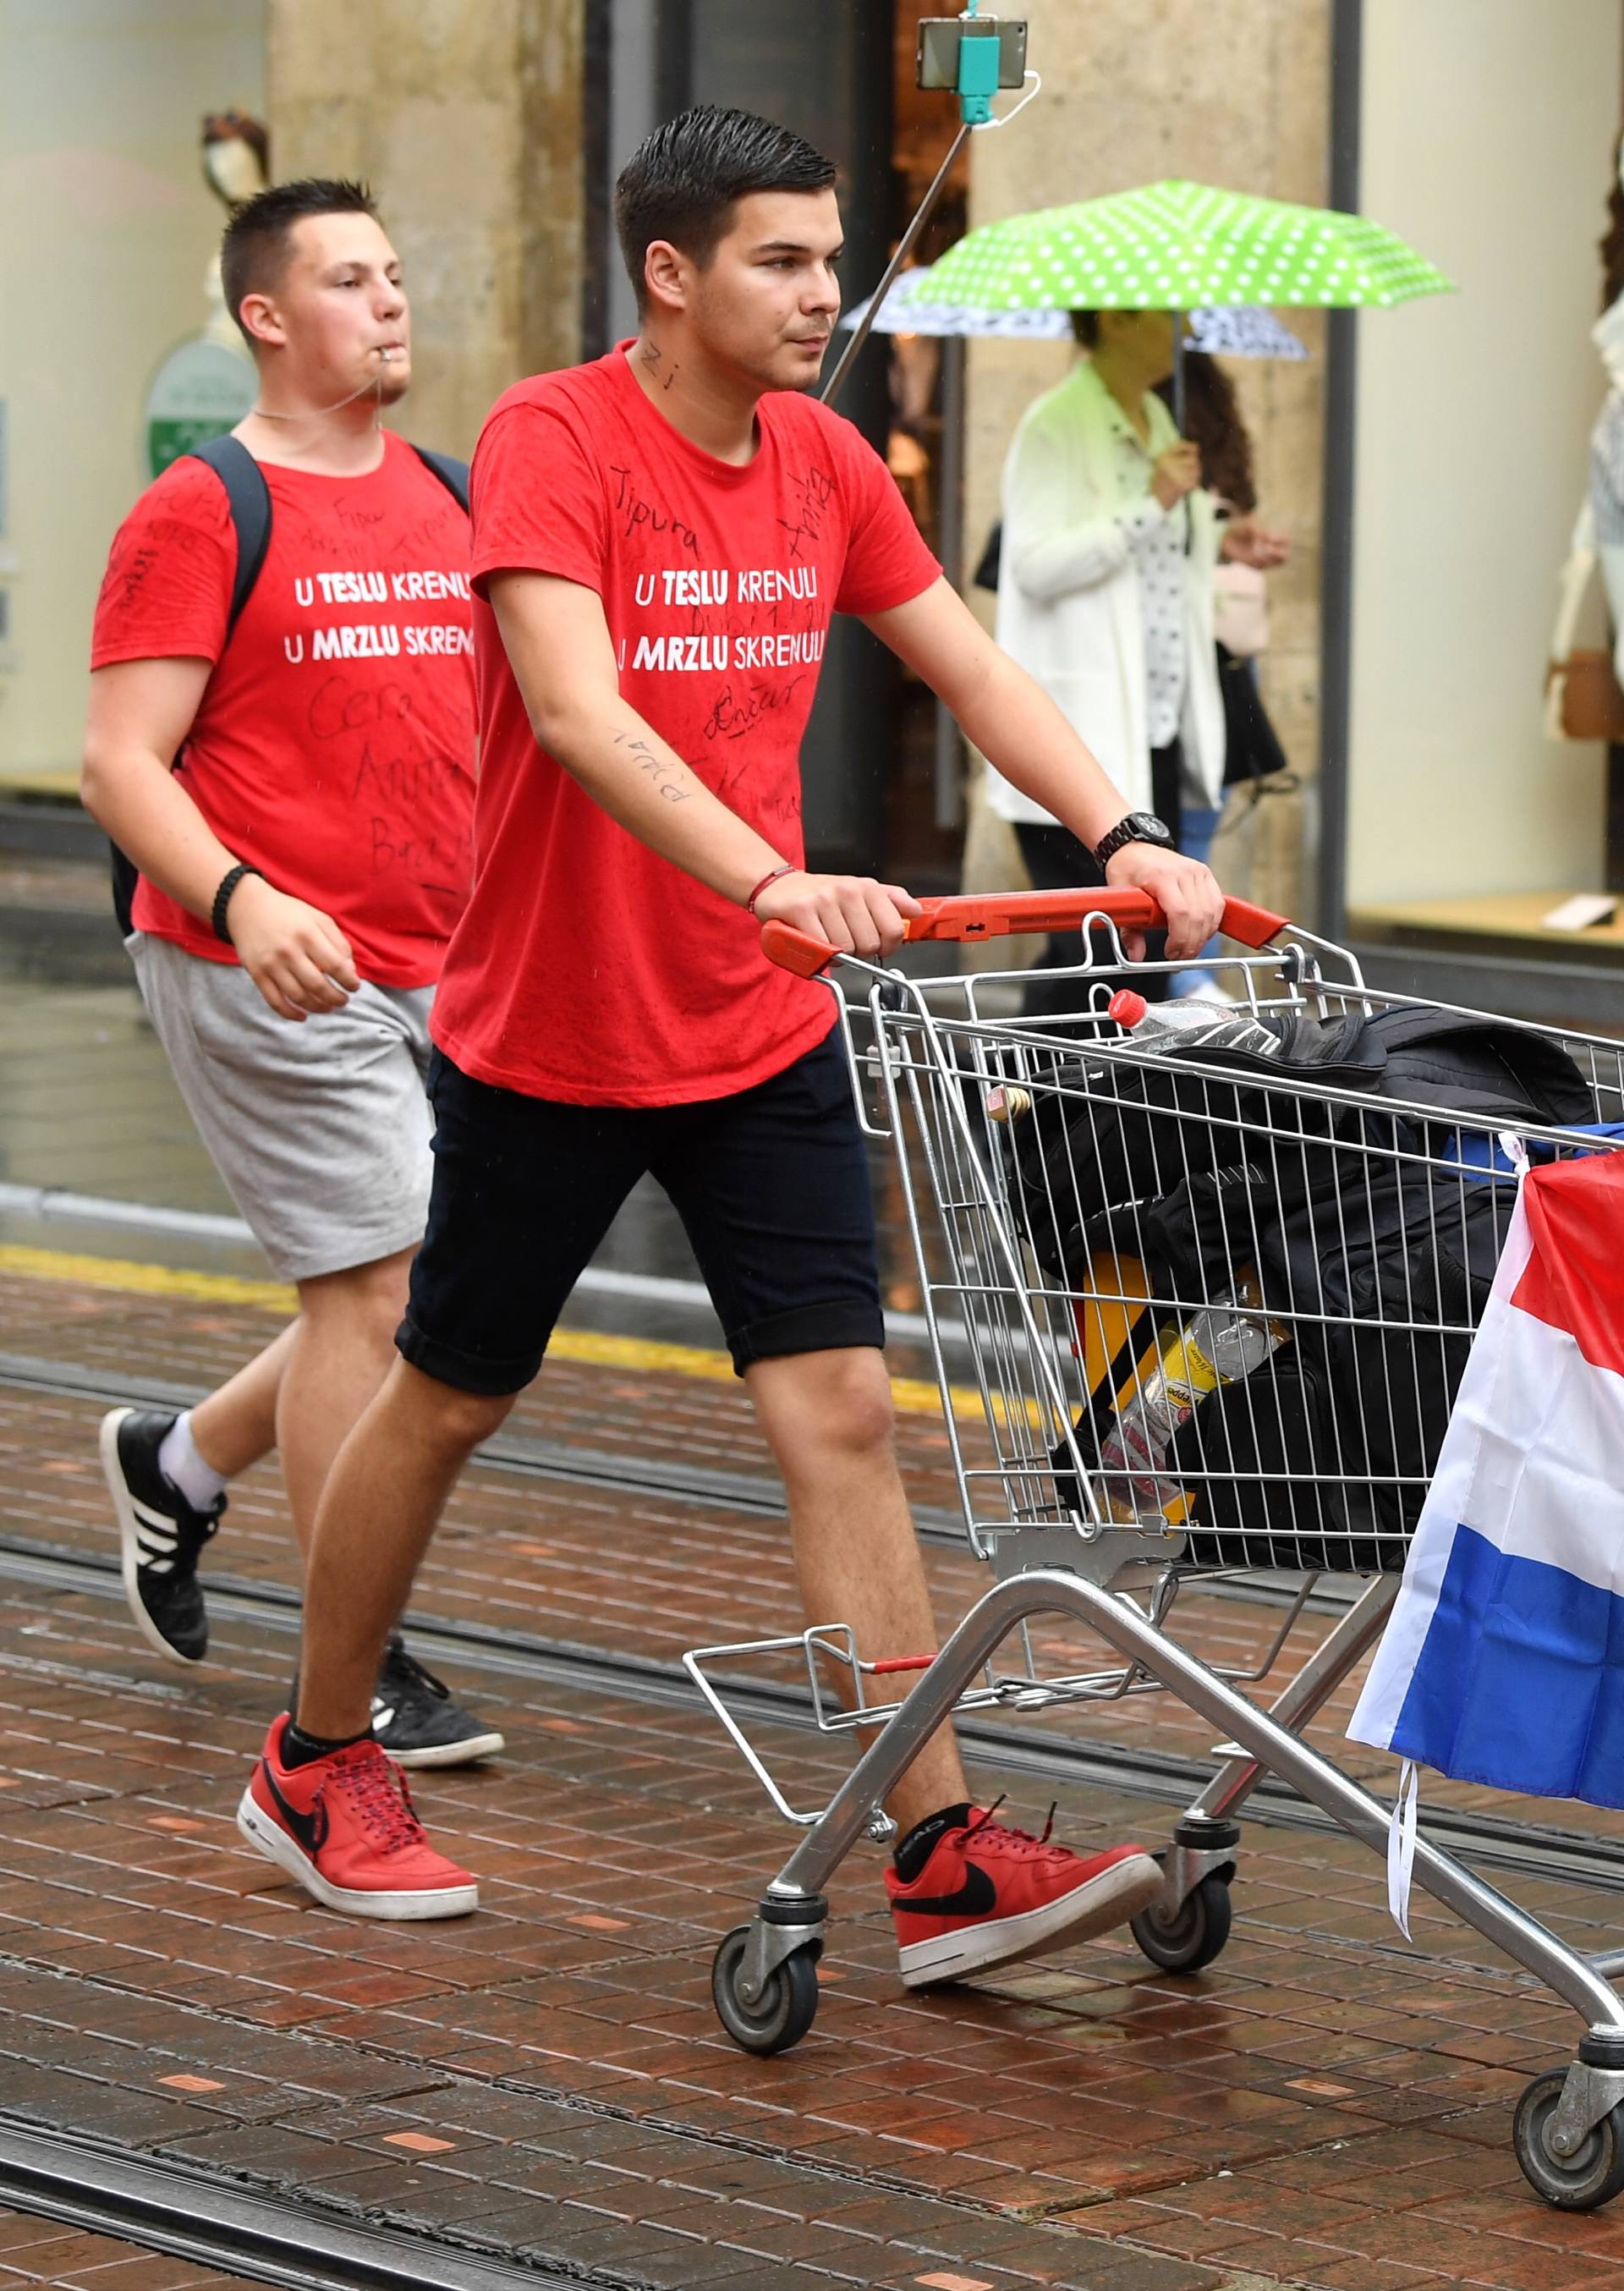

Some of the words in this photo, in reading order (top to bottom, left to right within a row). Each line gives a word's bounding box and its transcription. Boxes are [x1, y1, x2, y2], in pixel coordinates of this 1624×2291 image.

[294, 575, 315, 607] U
[315, 570, 388, 604] TESLU
[634, 573, 656, 607] U
[661, 569, 729, 607] TESLU
[737, 565, 818, 604] KRENULI
[283, 633, 304, 664] U
[311, 624, 401, 662] MRZLU
[632, 635, 728, 672] MRZLU
